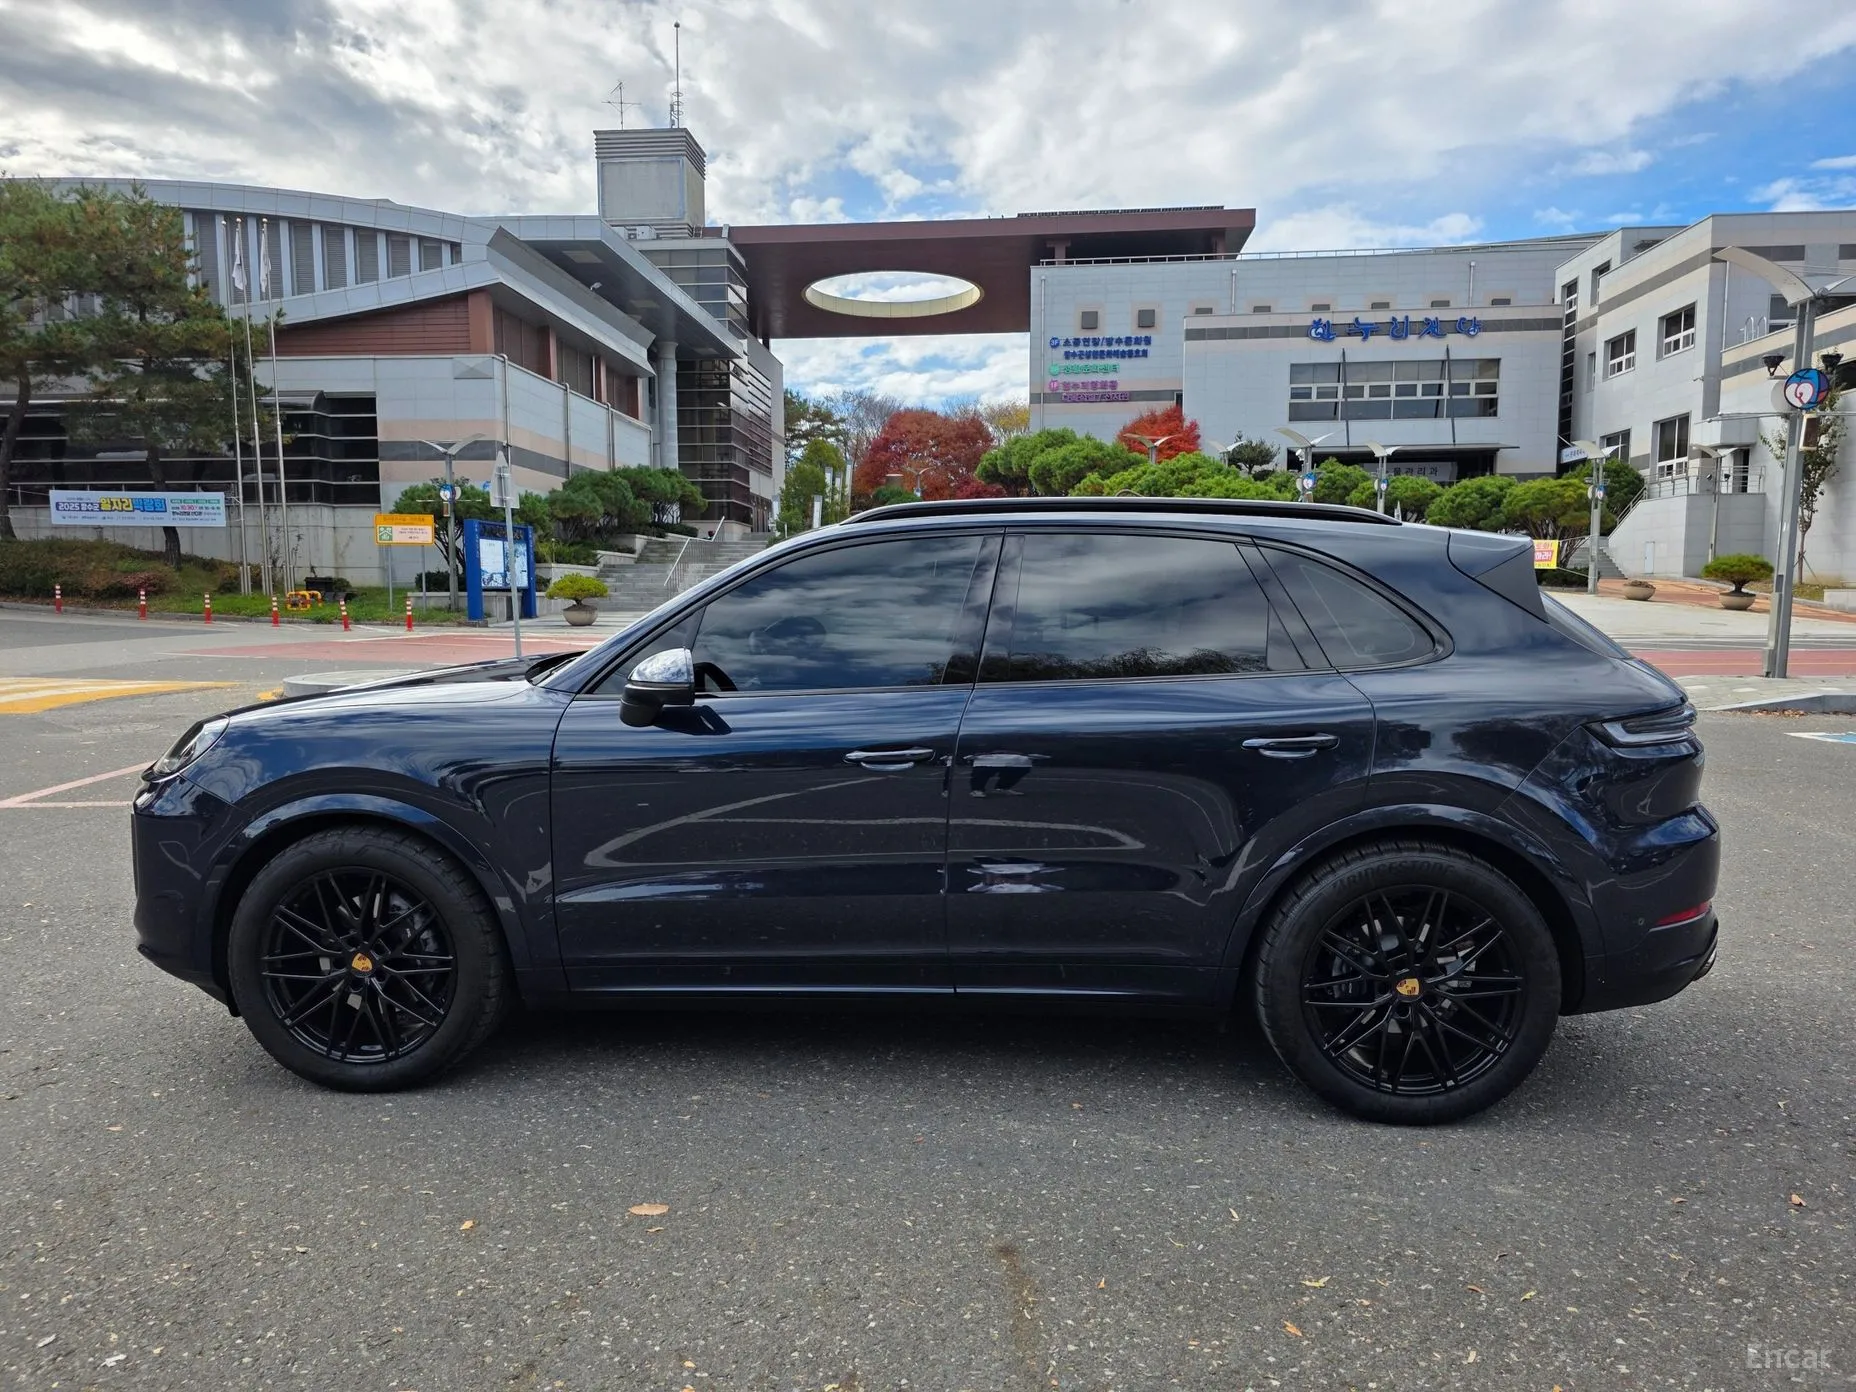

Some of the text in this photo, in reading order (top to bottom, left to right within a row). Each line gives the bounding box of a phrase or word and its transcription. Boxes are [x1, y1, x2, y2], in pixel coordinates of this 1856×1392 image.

[1307, 315, 1482, 342] 한누리전당
[58, 502, 80, 511] 2025
[80, 502, 100, 512] 장수군
